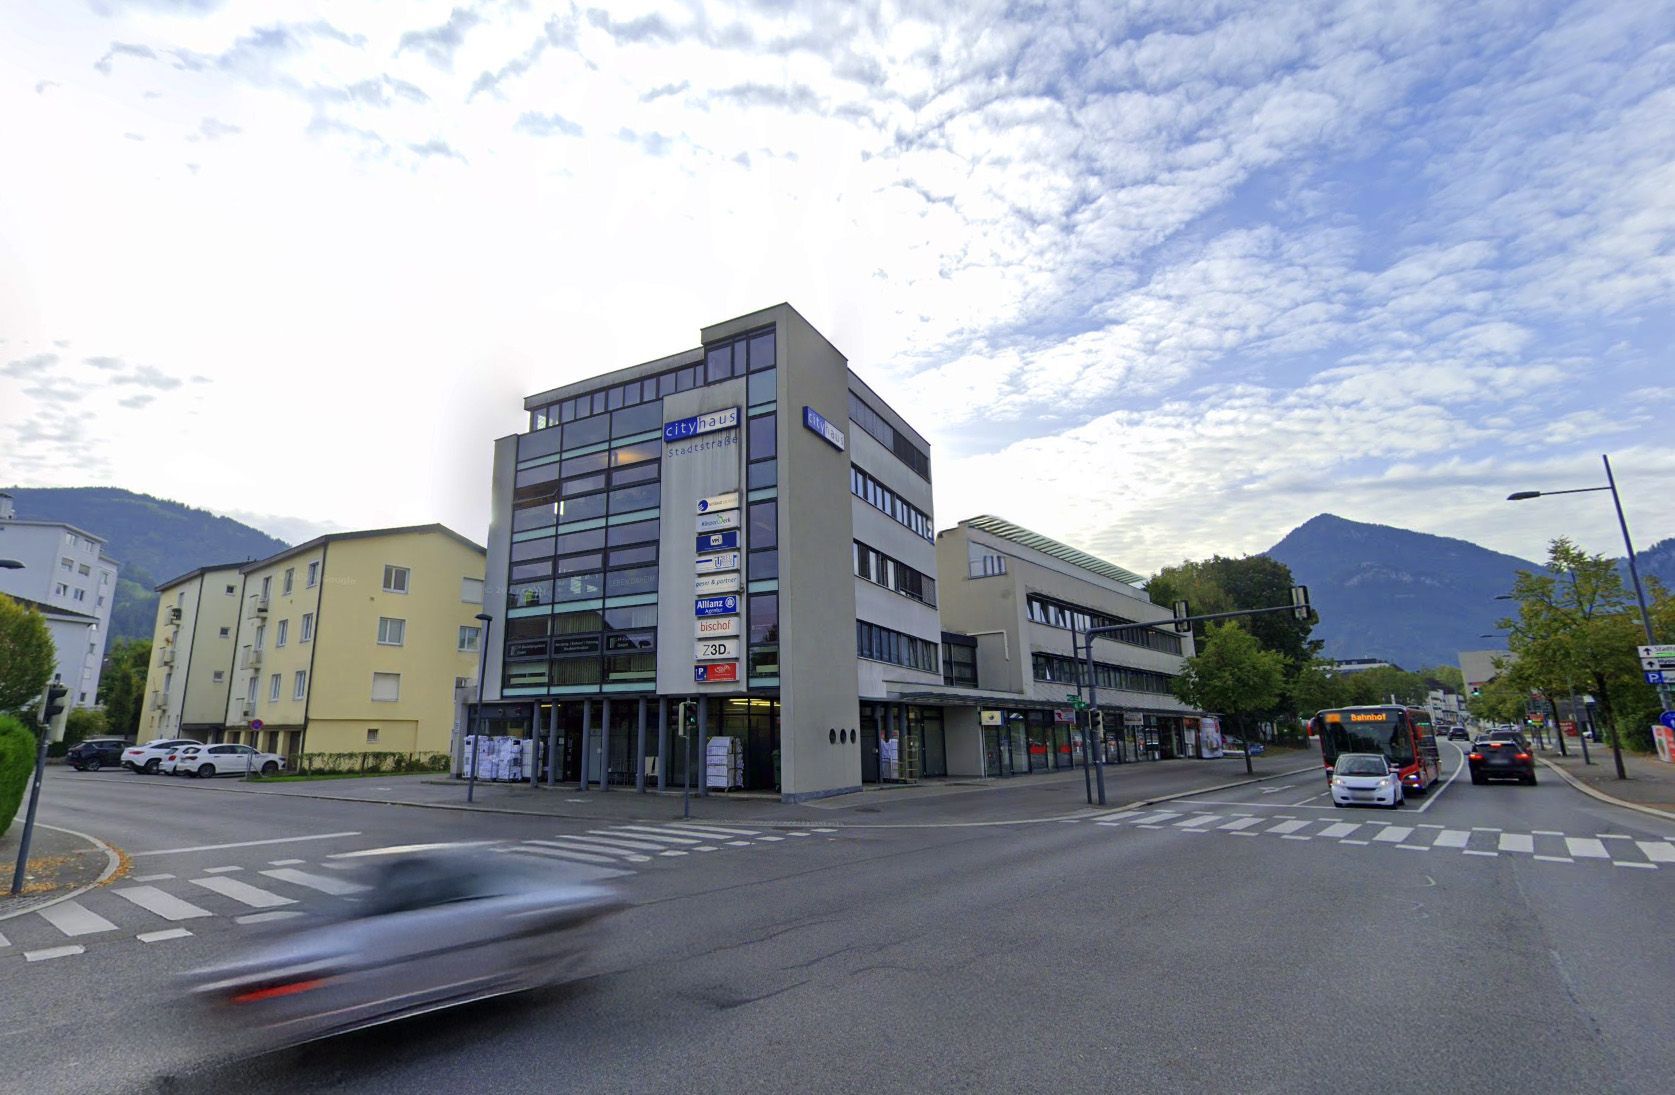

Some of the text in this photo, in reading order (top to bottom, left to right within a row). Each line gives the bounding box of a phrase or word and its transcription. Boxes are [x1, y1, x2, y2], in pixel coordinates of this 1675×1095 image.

[697, 600, 723, 609] Allianz
[700, 620, 731, 632] bischof
[1648, 673, 1660, 683] P
[1350, 713, 1386, 721] Bahnhof
